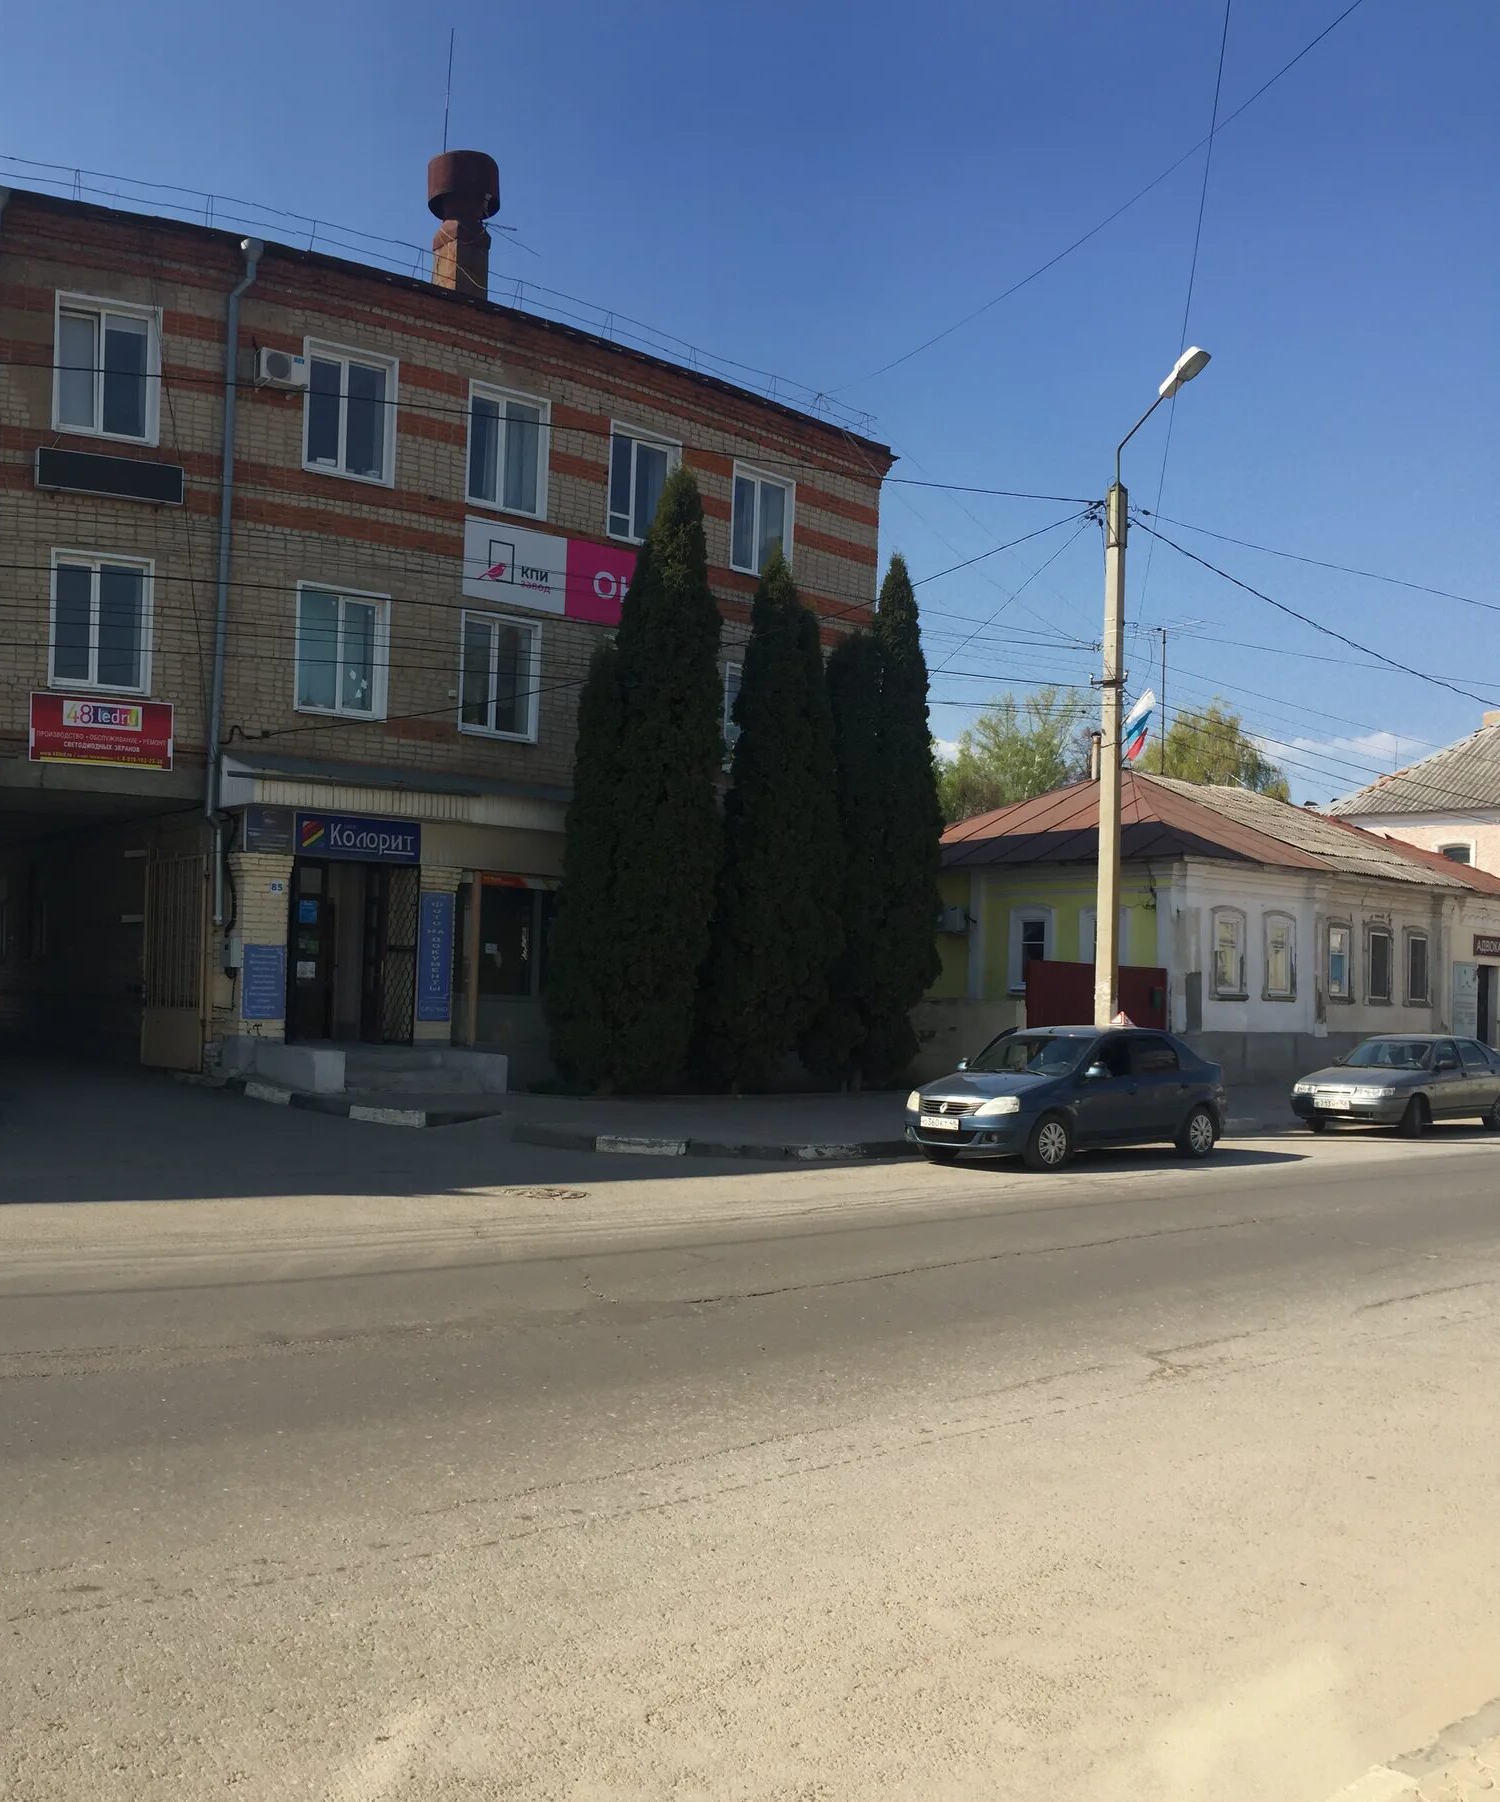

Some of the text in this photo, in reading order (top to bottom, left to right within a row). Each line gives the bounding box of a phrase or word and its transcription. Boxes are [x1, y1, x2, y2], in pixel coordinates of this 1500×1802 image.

[36, 731, 84, 739] ПРОИЗВОДСТВО
[89, 735, 138, 745] ОБСЛУЖИВАНИЕ
[63, 741, 140, 753] СВЕТОДИОДНЫХ ЭКРАНОВ
[330, 824, 415, 855] Колорит
[271, 883, 283, 891] 85
